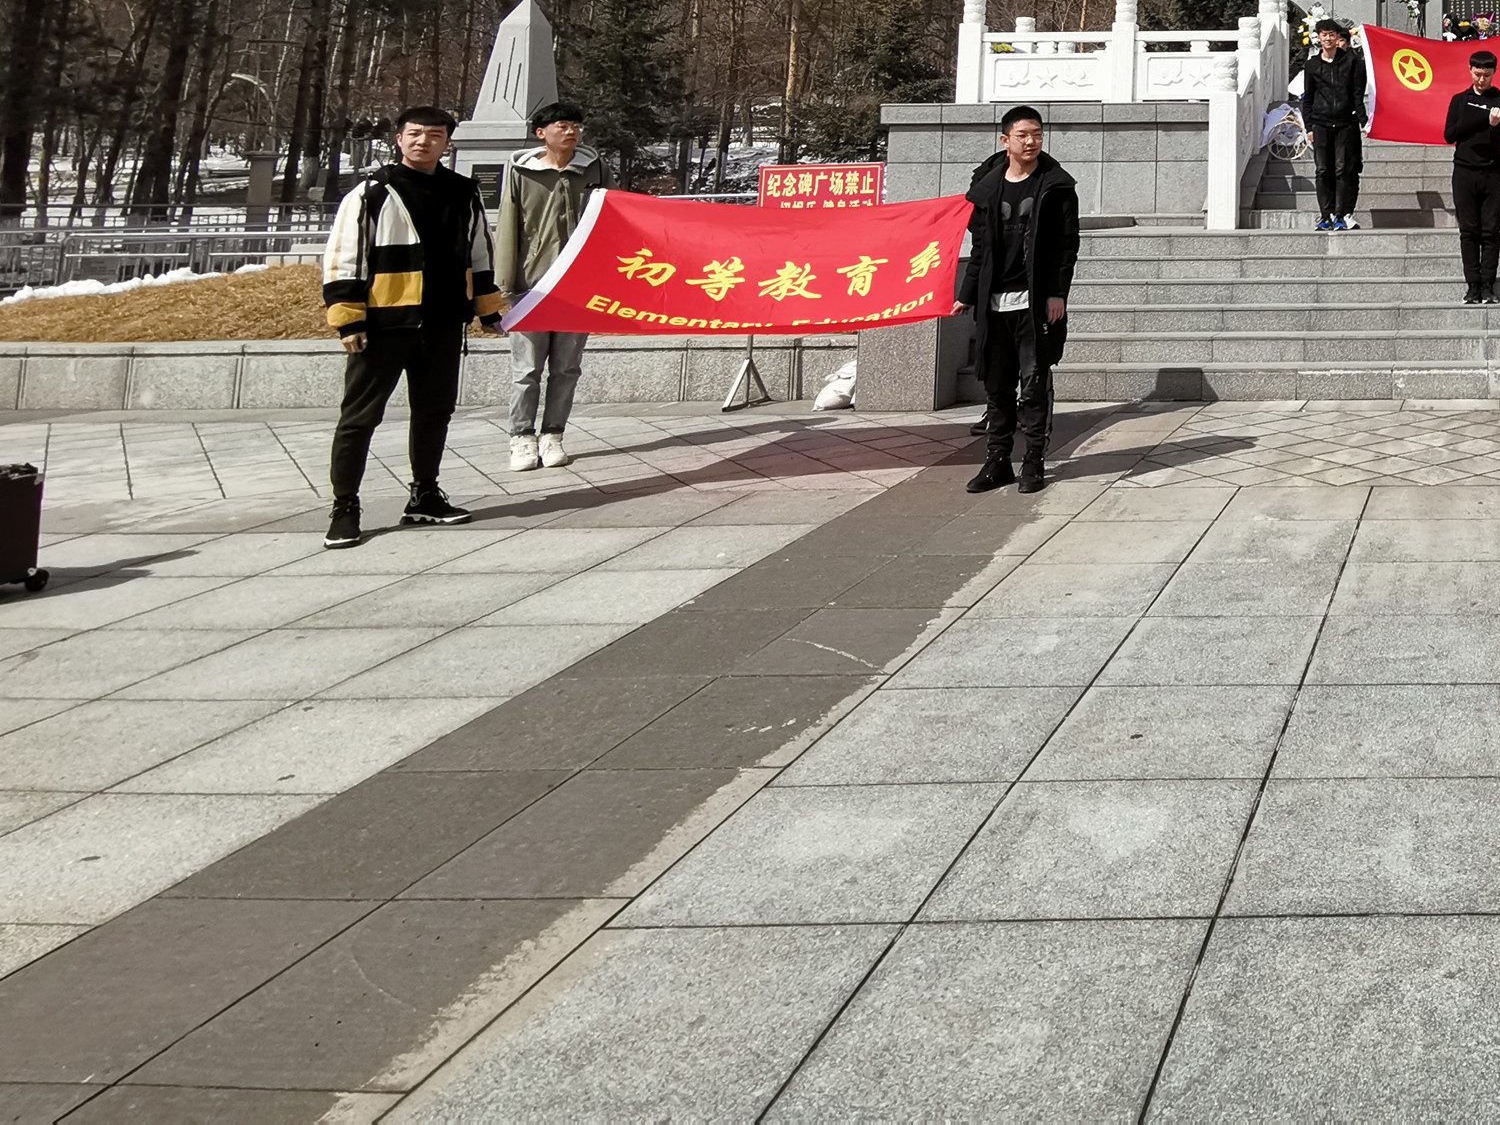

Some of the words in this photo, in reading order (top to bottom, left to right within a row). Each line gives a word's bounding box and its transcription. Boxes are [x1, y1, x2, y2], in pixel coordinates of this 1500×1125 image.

[766, 170, 875, 197] 纪念碑广场禁止
[616, 240, 942, 302] 初等教育系
